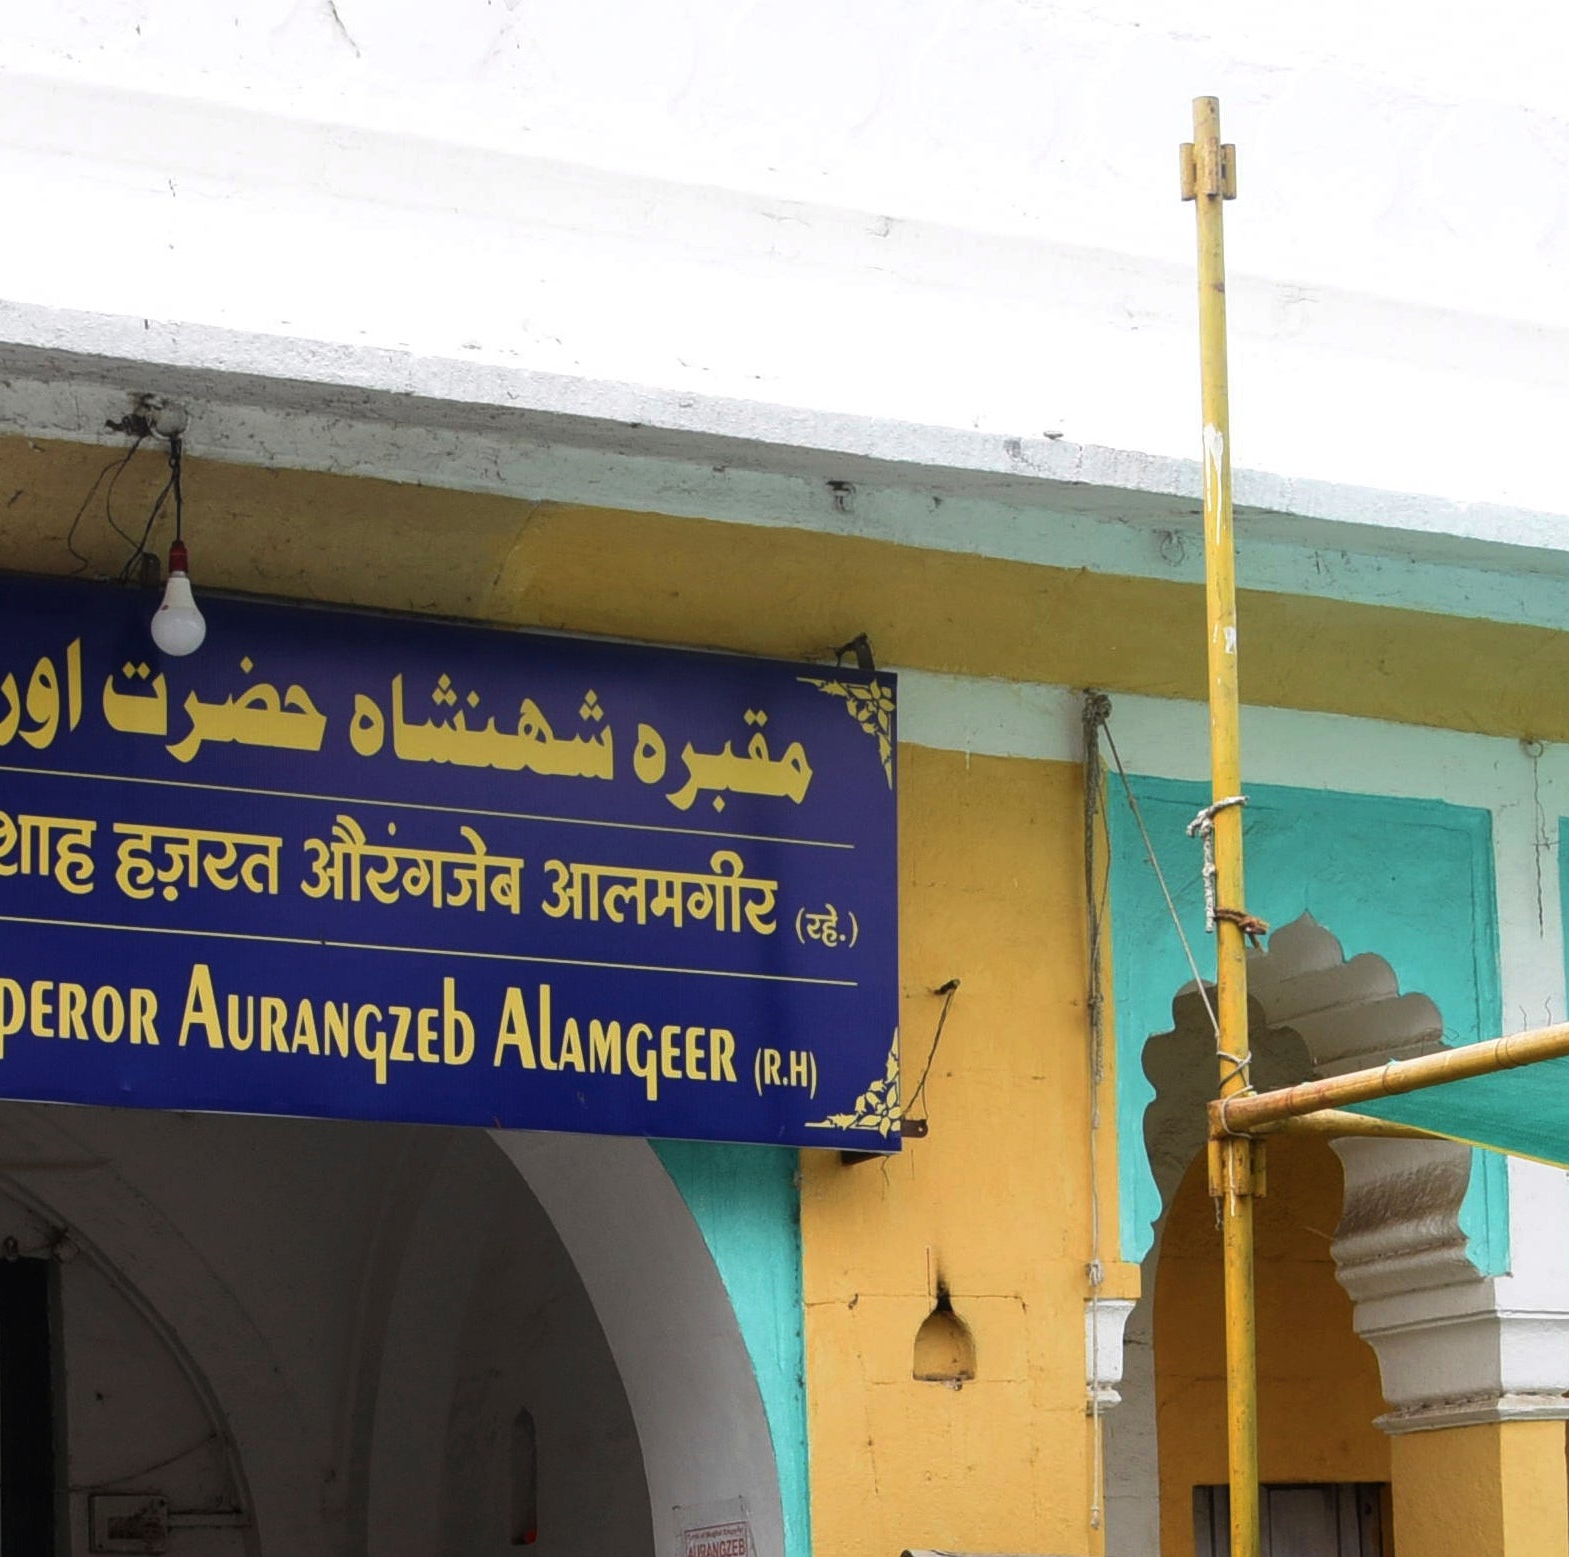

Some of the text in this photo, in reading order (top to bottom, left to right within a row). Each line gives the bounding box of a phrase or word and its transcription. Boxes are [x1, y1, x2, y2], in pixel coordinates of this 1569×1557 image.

[103, 658, 327, 763] حضرت
[113, 822, 282, 903] हज़रत
[301, 815, 523, 915] औरंगजेब
[542, 850, 778, 935] आलमगीर
[179, 963, 475, 1084] Aurangzeb
[494, 984, 736, 1100] Alamgeer
[755, 1049, 817, 1098] (R.H)
